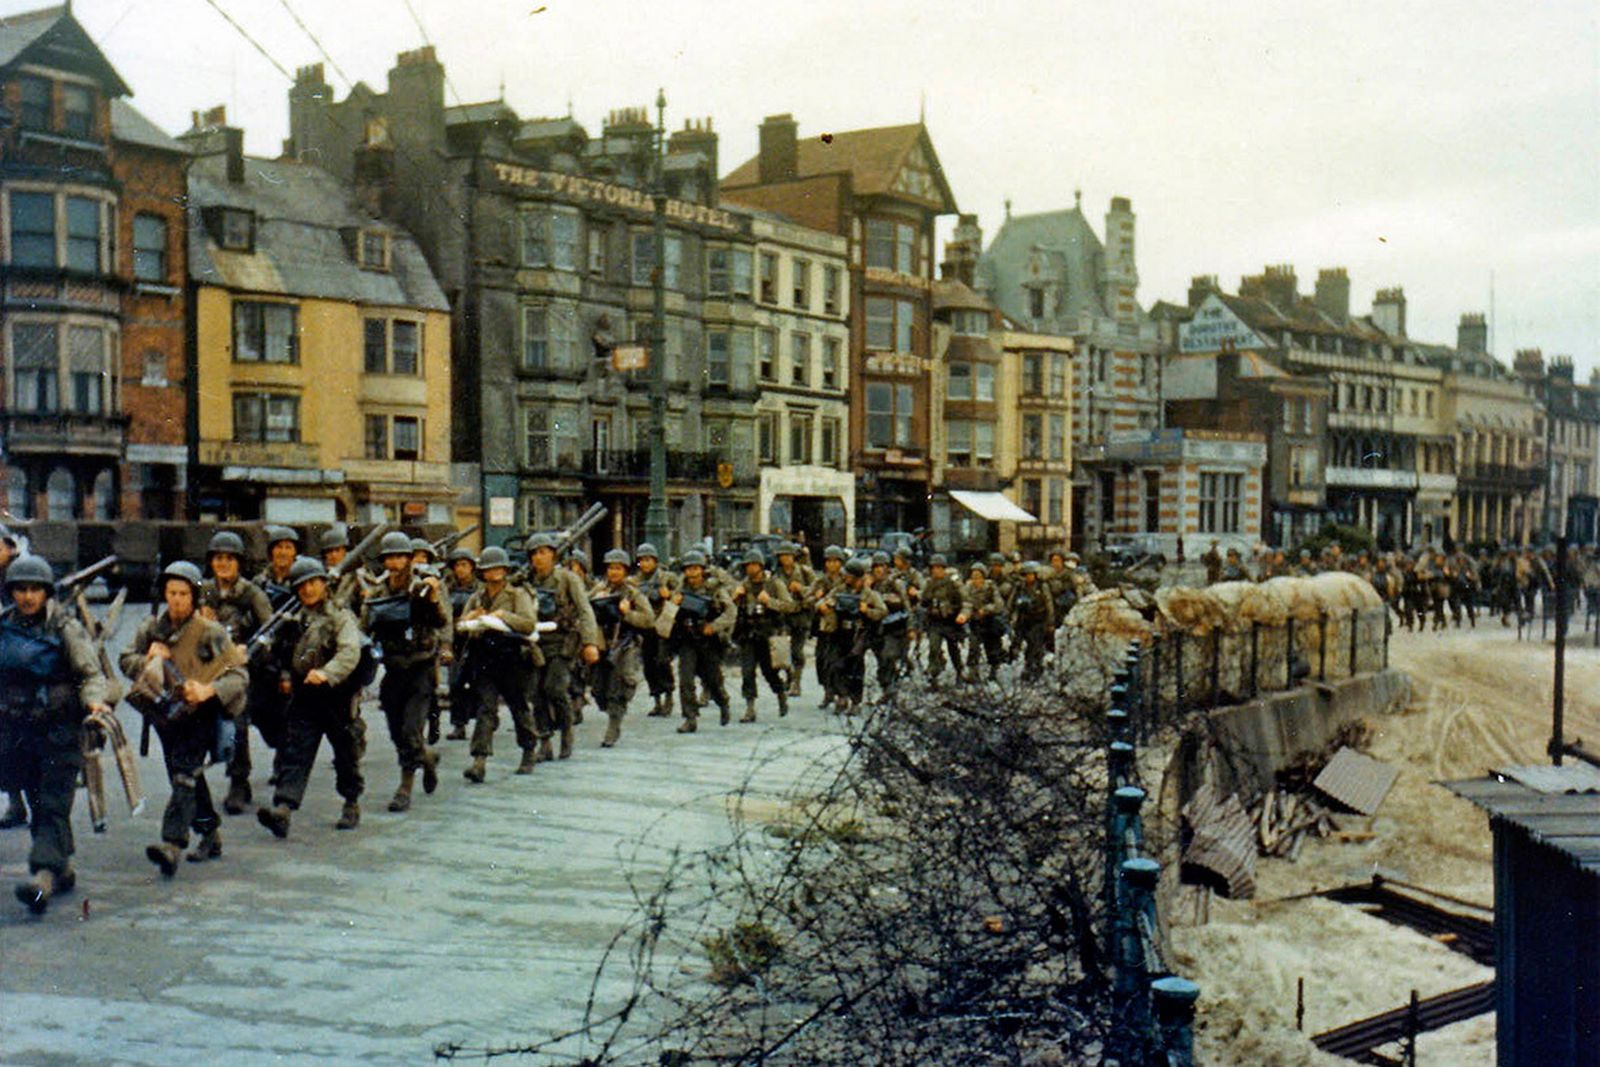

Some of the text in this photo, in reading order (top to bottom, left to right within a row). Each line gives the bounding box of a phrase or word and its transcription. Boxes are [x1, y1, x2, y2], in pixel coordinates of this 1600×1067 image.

[494, 162, 737, 229] THE VICTORIA HOTEL
